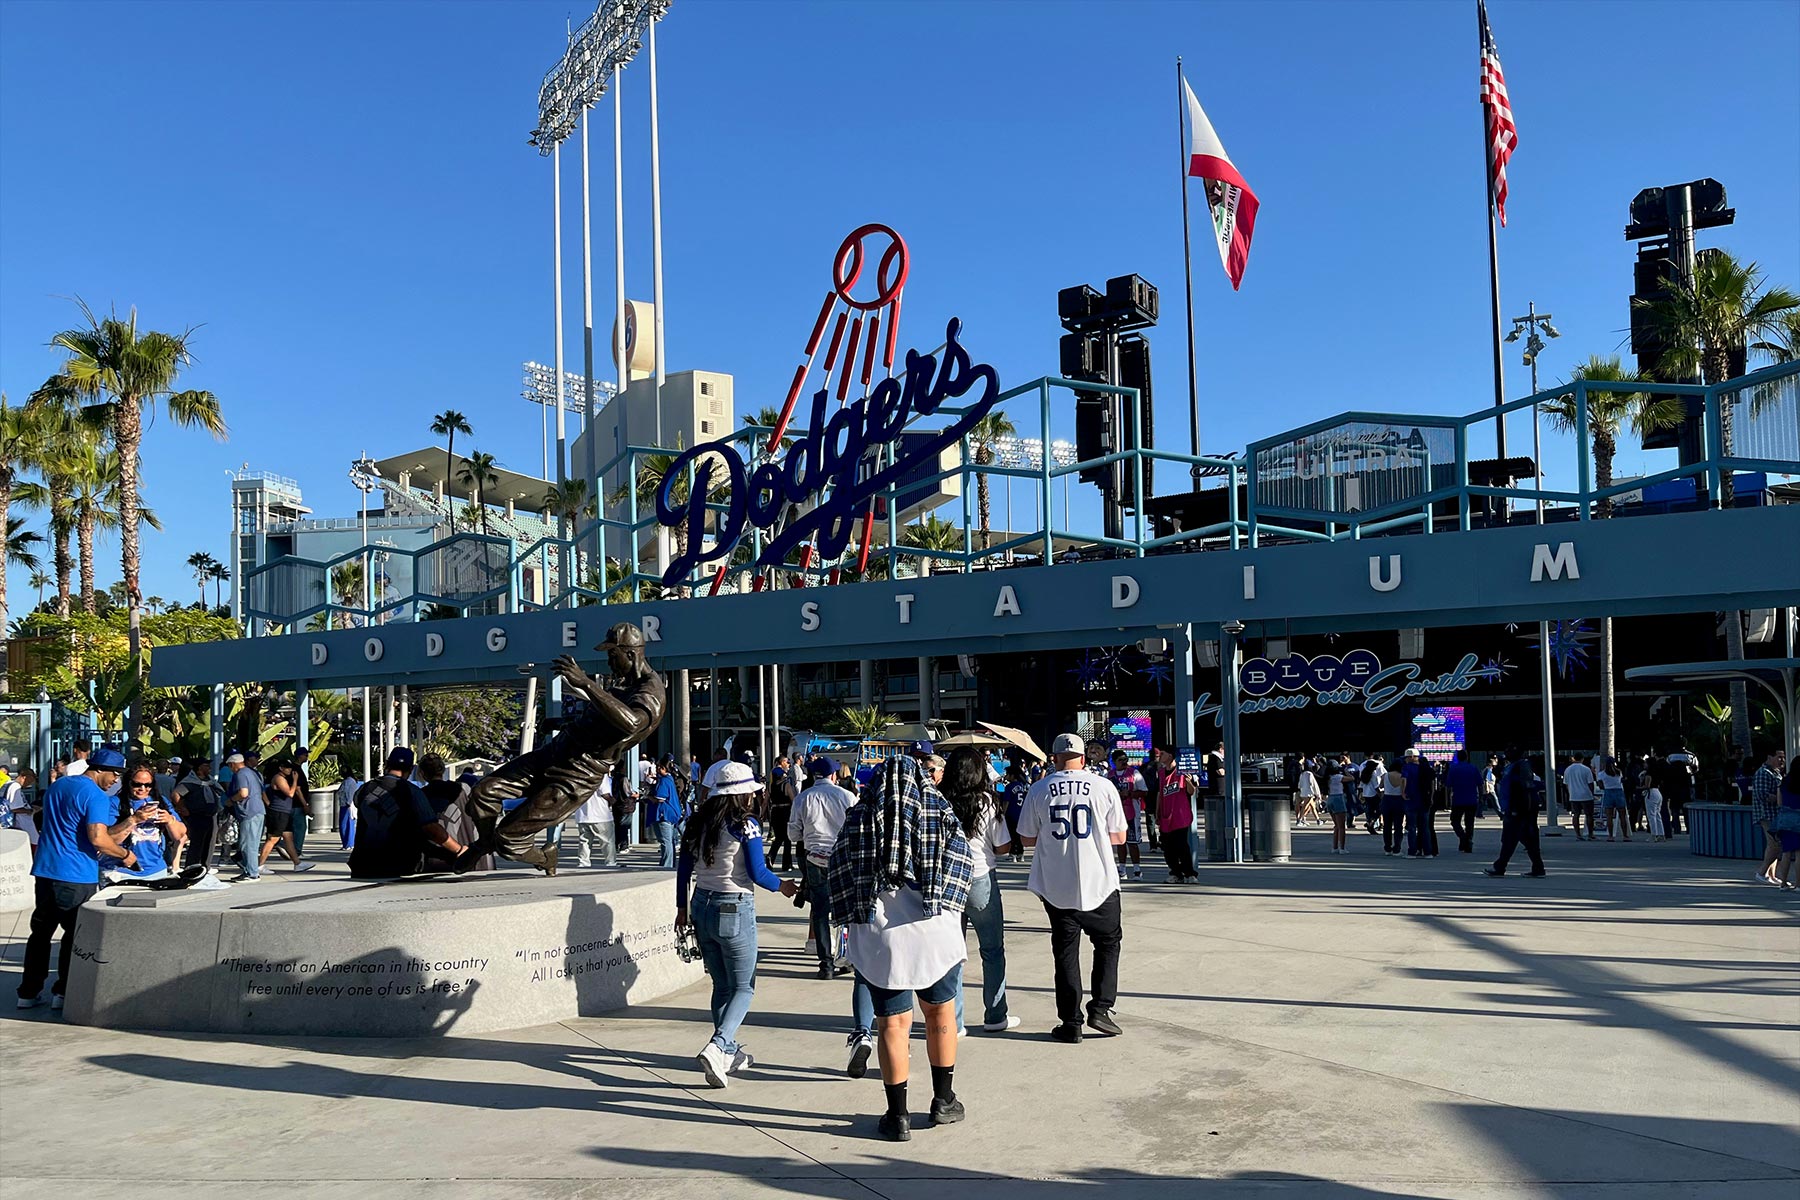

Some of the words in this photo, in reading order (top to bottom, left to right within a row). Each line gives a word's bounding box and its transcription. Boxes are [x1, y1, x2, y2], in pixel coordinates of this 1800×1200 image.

[656, 316, 1000, 588] Dodgers
[1297, 443, 1417, 481] ULTRA
[311, 615, 663, 666] DODGER
[800, 541, 1581, 632] STADIUM
[1194, 684, 1309, 727] Haven
[1363, 653, 1480, 713] Earth
[1247, 660, 1372, 685] BLUE
[1016, 792, 1024, 807] 5
[1049, 781, 1091, 797] BETTS
[1049, 804, 1092, 841] 50
[544, 946, 561, 959] not
[563, 934, 614, 956] concerned
[633, 930, 649, 944] your
[650, 924, 667, 937] liking
[275, 960, 297, 973] not
[300, 963, 316, 973] an
[320, 959, 385, 974] American
[390, 960, 402, 973] in
[407, 957, 431, 973] this
[434, 957, 489, 972] country
[531, 966, 546, 983] All
[556, 962, 573, 978] ask
[576, 963, 584, 974] is
[586, 958, 603, 972] that
[605, 957, 622, 972] you
[623, 948, 650, 963] respect
[651, 946, 661, 956] me
[661, 943, 669, 953] as
[247, 980, 272, 994] free
[276, 981, 303, 995] until
[306, 986, 344, 999] every
[347, 985, 373, 996] one
[378, 980, 394, 996] of
[396, 985, 411, 995] us
[415, 982, 426, 994] is
